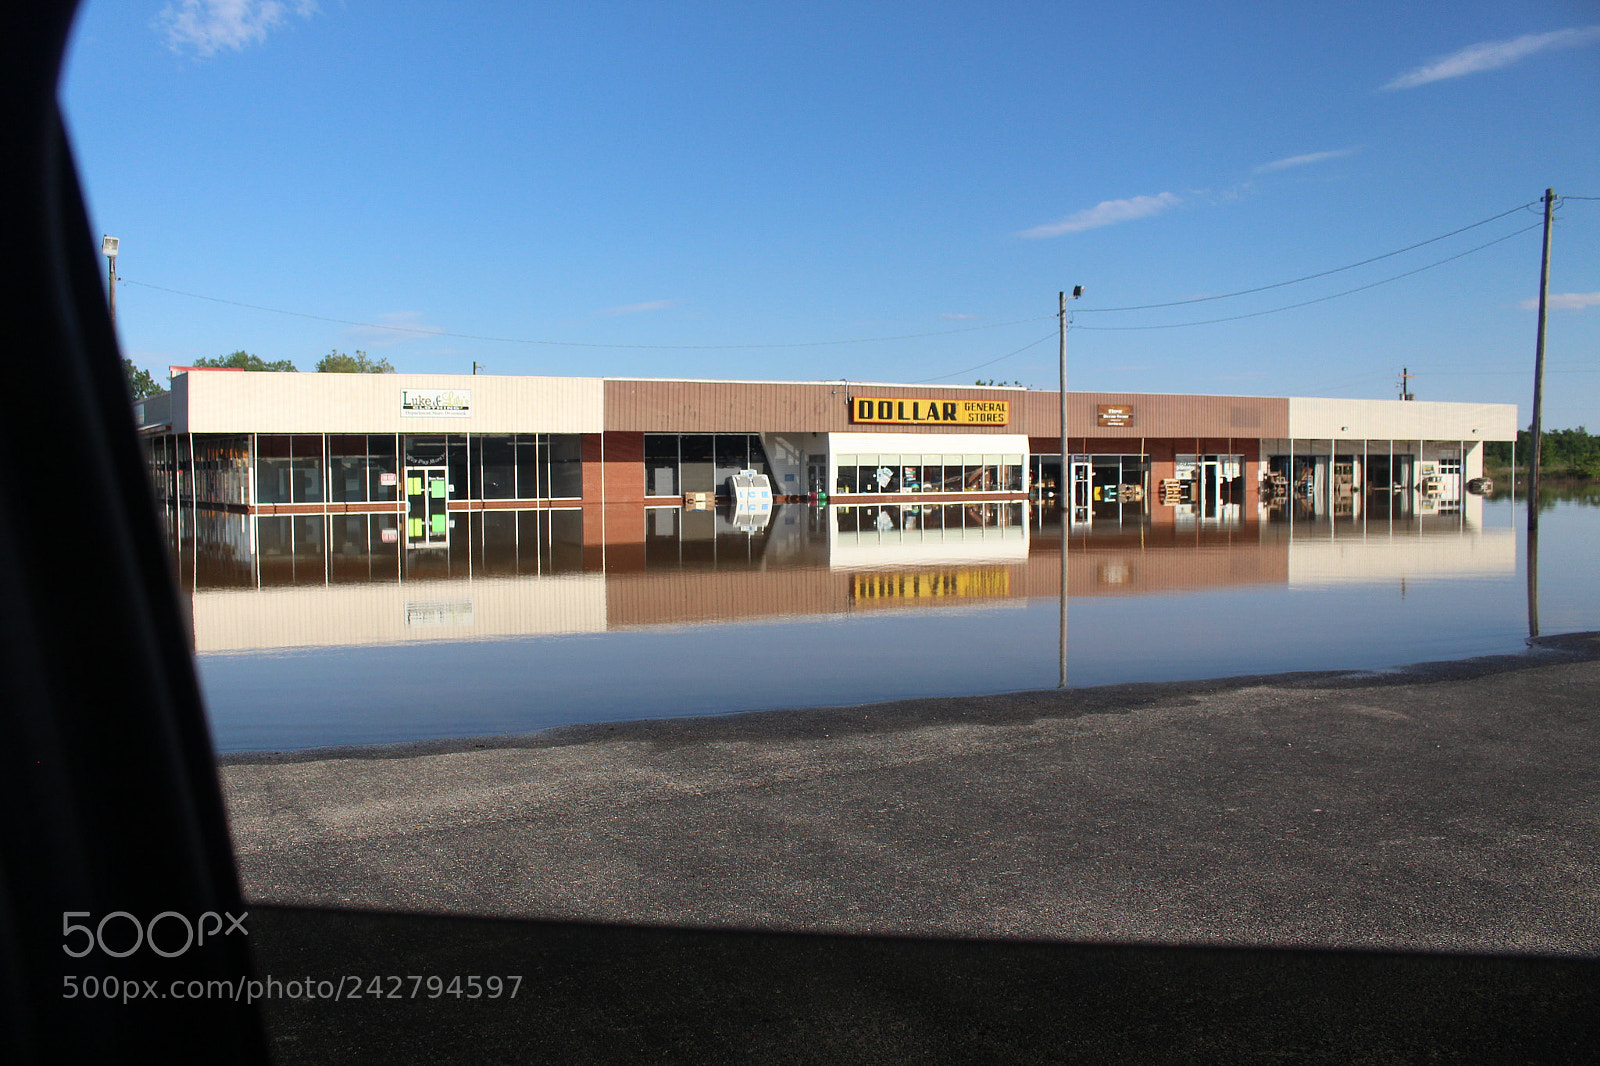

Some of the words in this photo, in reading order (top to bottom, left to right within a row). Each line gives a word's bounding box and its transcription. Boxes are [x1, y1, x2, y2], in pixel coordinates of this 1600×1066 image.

[402, 391, 432, 406] Luke
[858, 400, 957, 421] DOLLAR
[964, 402, 1007, 412] GENERAL
[968, 412, 1005, 422] STORES
